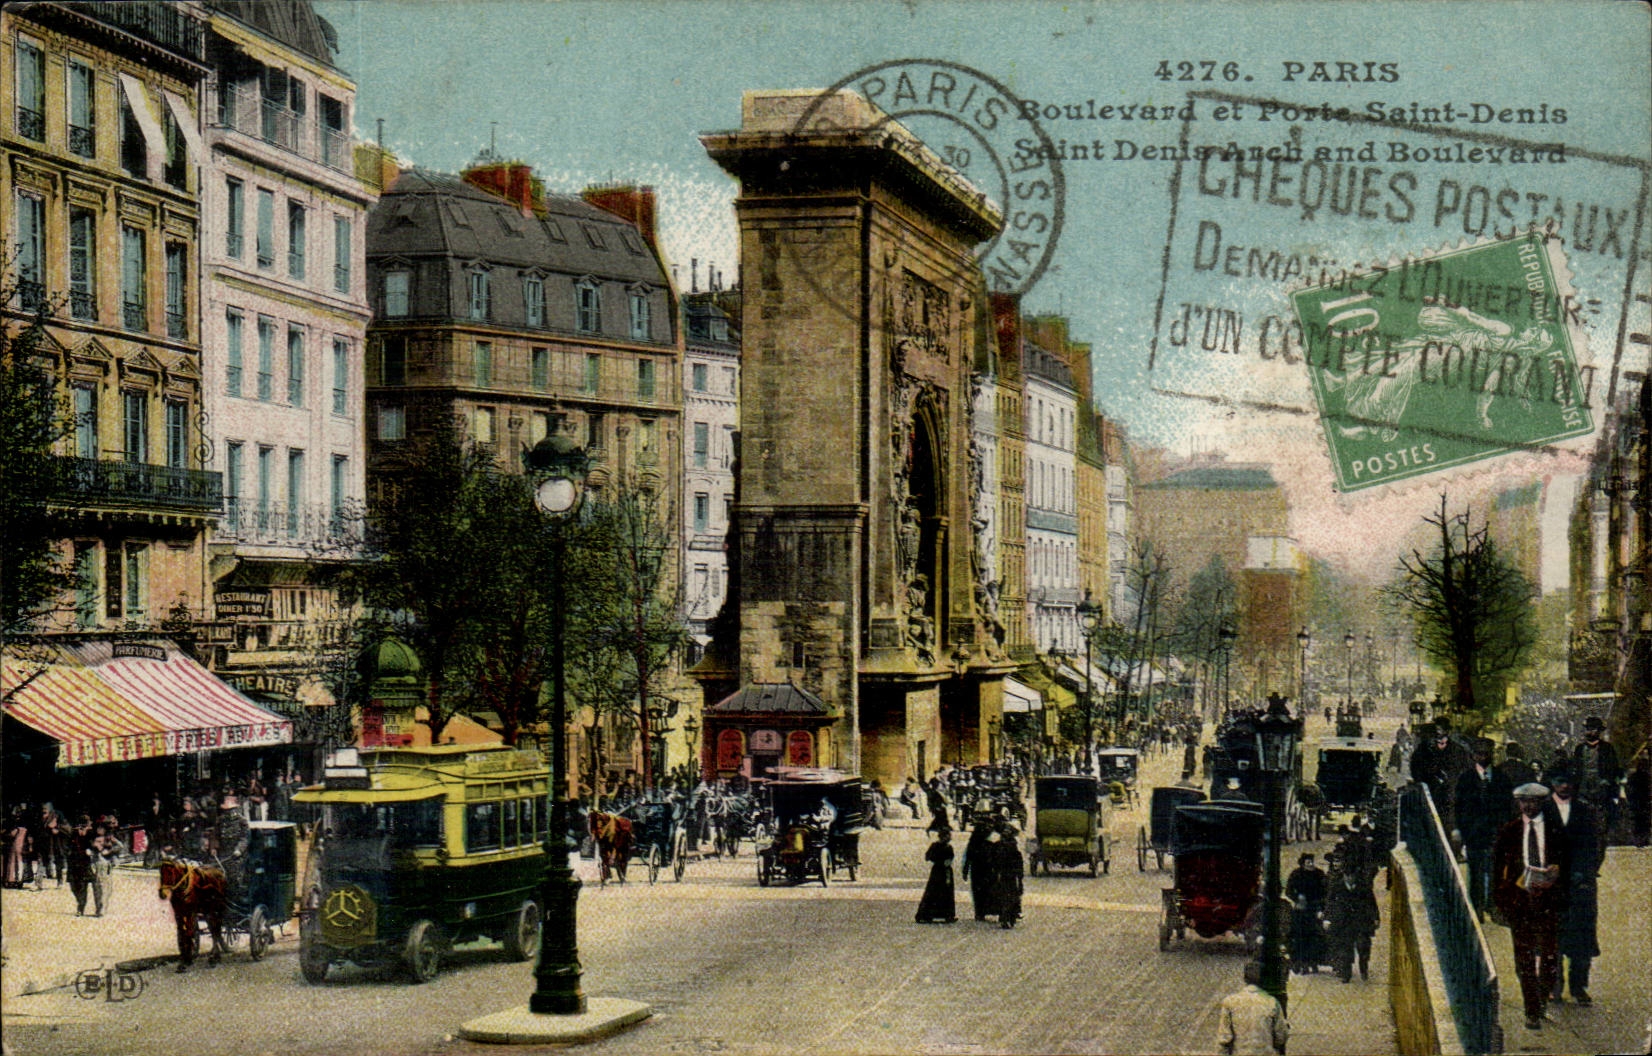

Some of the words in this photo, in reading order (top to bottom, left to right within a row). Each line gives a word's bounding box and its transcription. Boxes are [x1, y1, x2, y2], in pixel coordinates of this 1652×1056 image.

[1352, 443, 1436, 479] POSTES
[215, 592, 267, 604] RESTAURANT
[114, 643, 166, 660] PARFUMERIE
